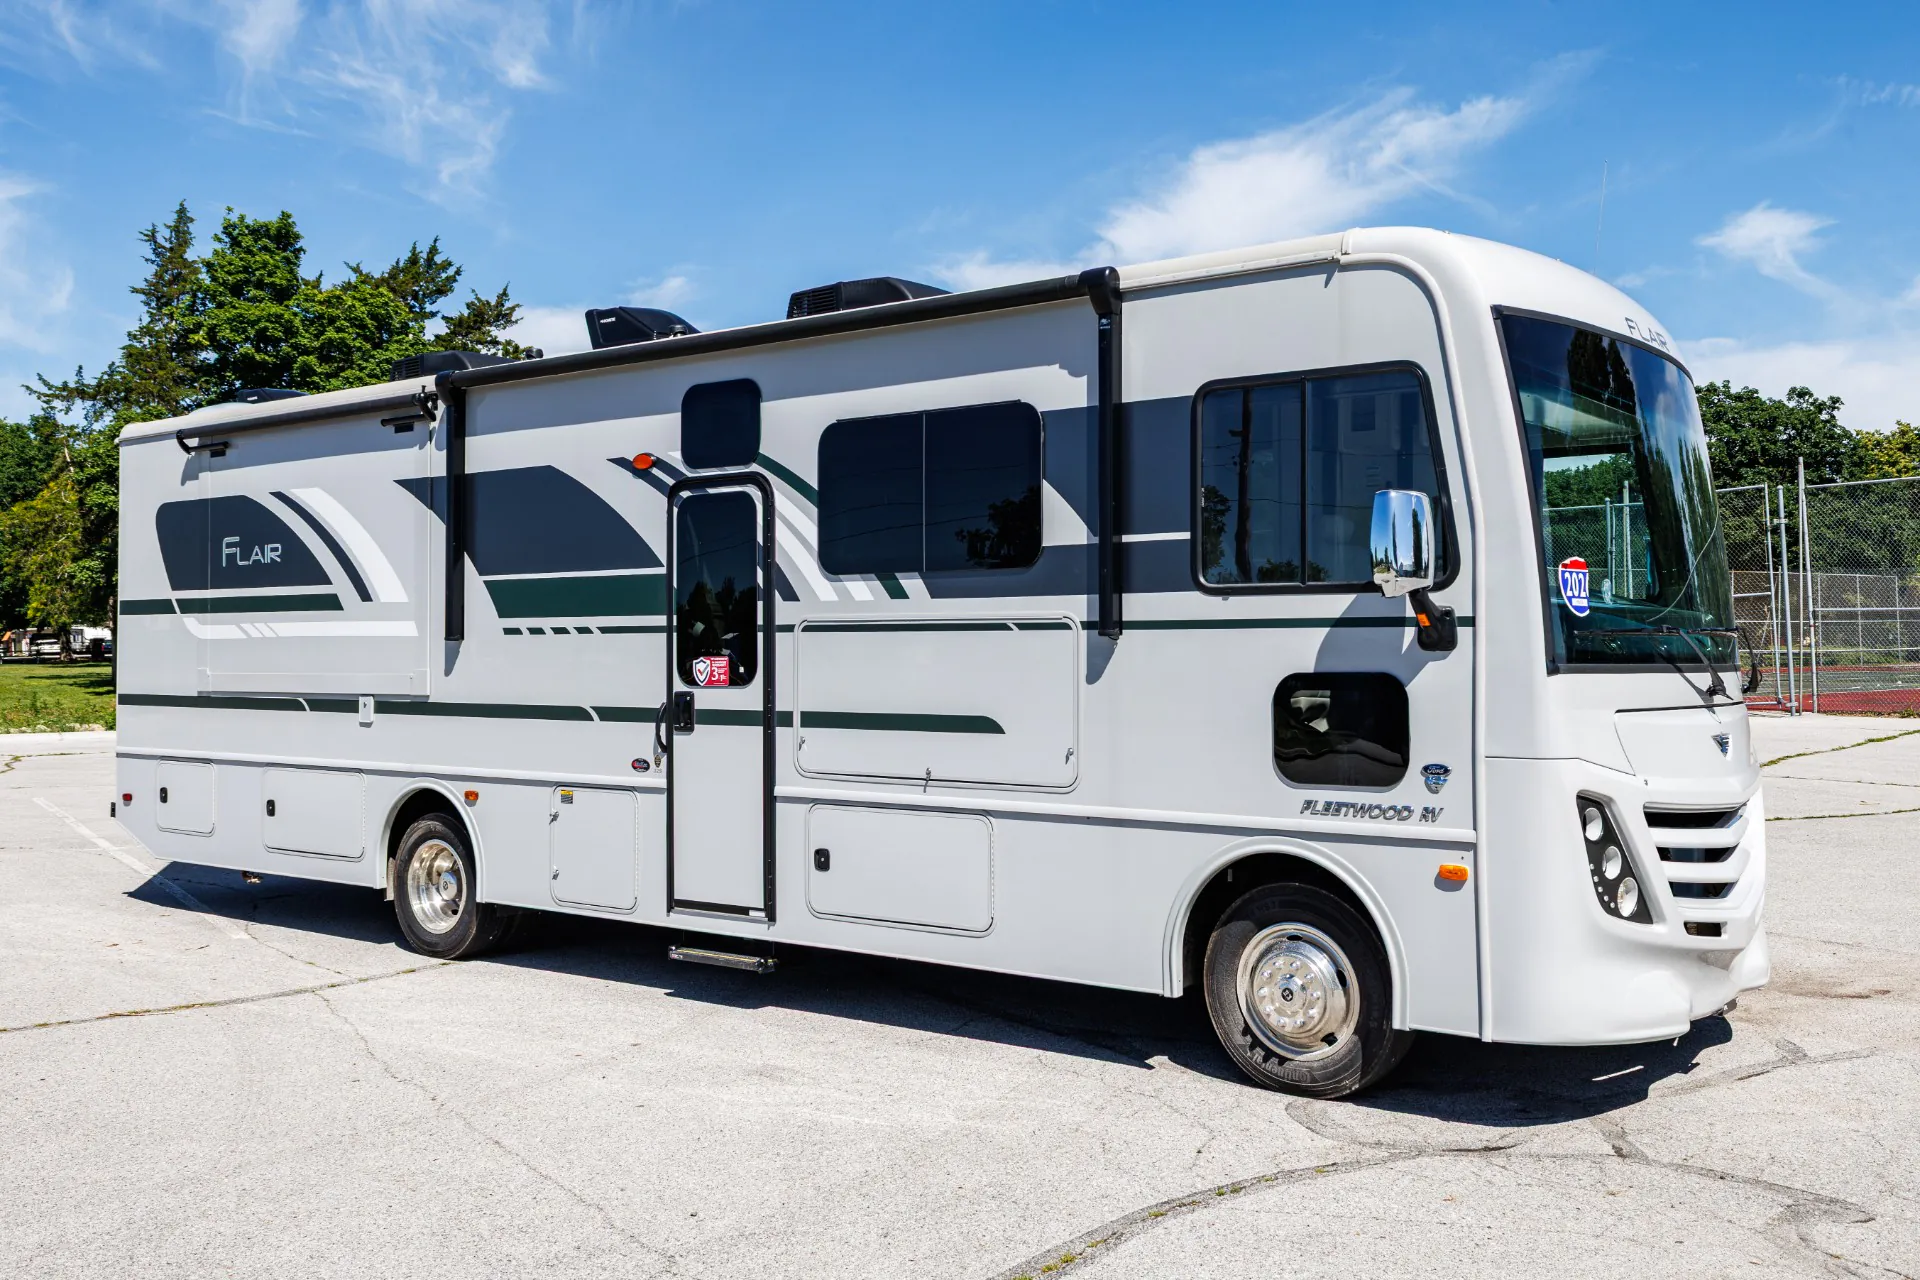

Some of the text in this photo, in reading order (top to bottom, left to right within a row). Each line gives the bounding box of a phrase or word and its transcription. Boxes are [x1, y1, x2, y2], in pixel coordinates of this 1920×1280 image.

[222, 536, 282, 567] FLAIR
[1427, 766, 1445, 774] Ford
[1300, 799, 1444, 823] FLEETWOOD RV
